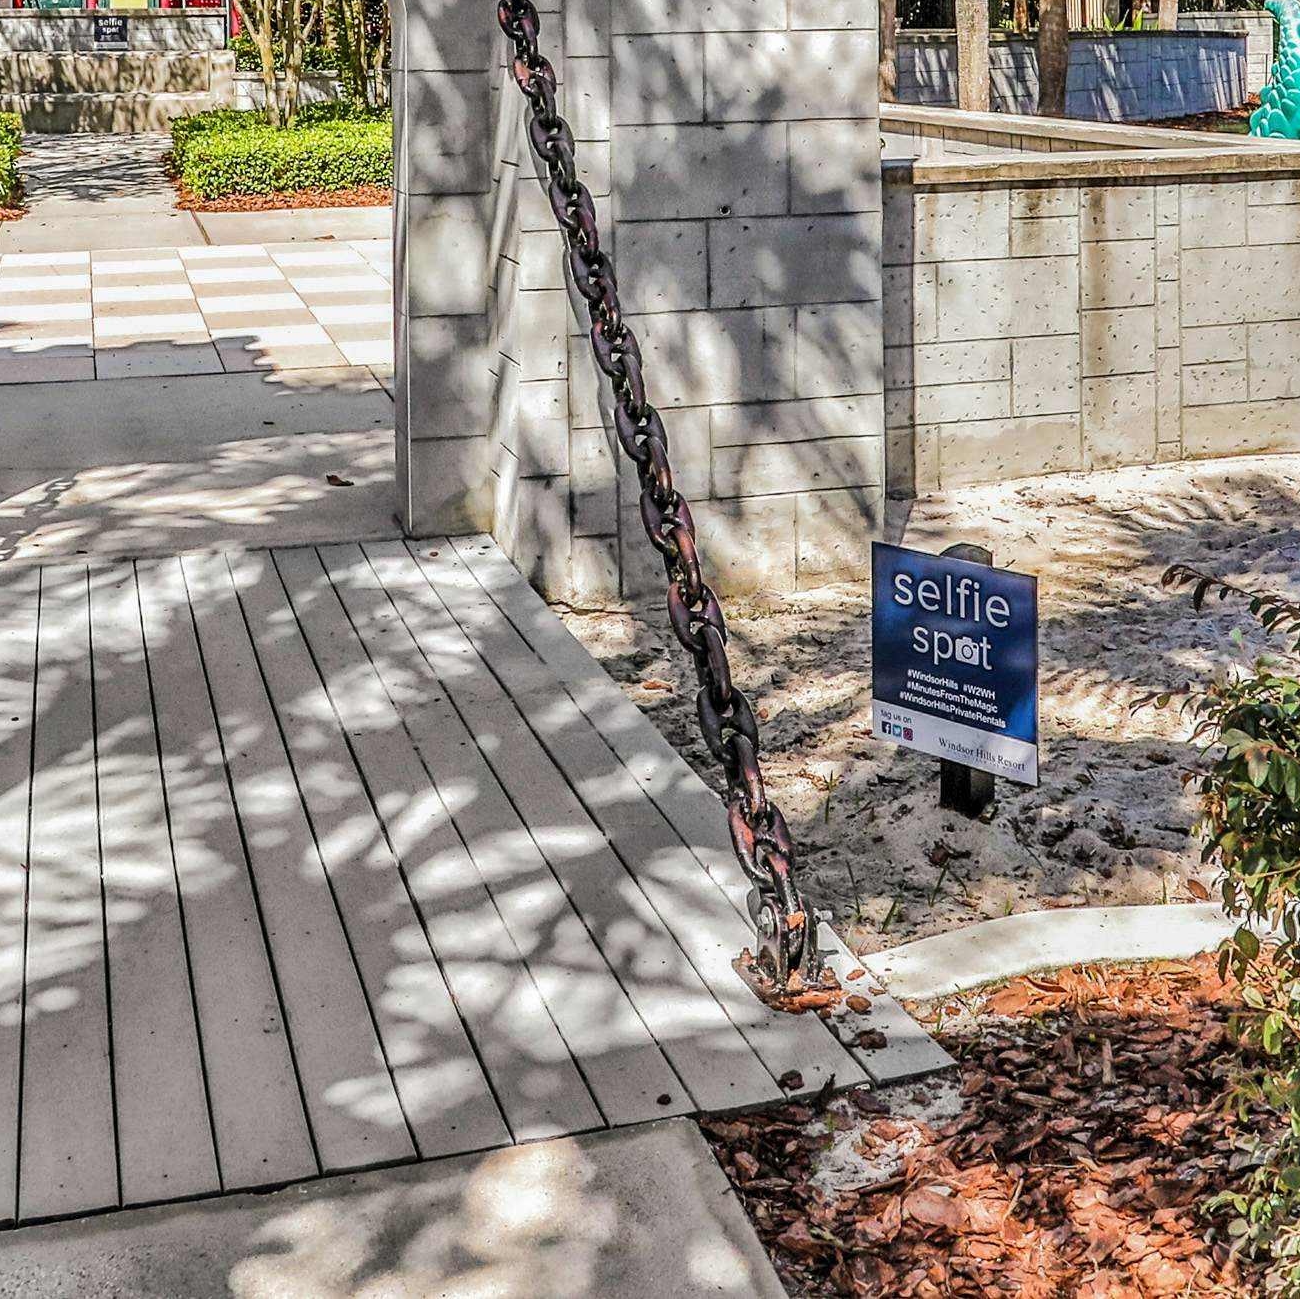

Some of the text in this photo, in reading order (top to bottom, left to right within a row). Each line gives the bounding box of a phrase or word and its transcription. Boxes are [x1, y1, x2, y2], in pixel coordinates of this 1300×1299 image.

[894, 573, 1010, 628] selfie
[906, 680, 998, 714] #MinutesFromTheMagic
[907, 668, 996, 700] #WindsorHills #W2WH
[880, 709, 912, 724] tag us on
[899, 690, 1007, 729] #WindsorHillsPrivateRentals
[938, 737, 974, 757] Windsor
[976, 748, 995, 762] Hills
[997, 755, 1026, 772] Resort
